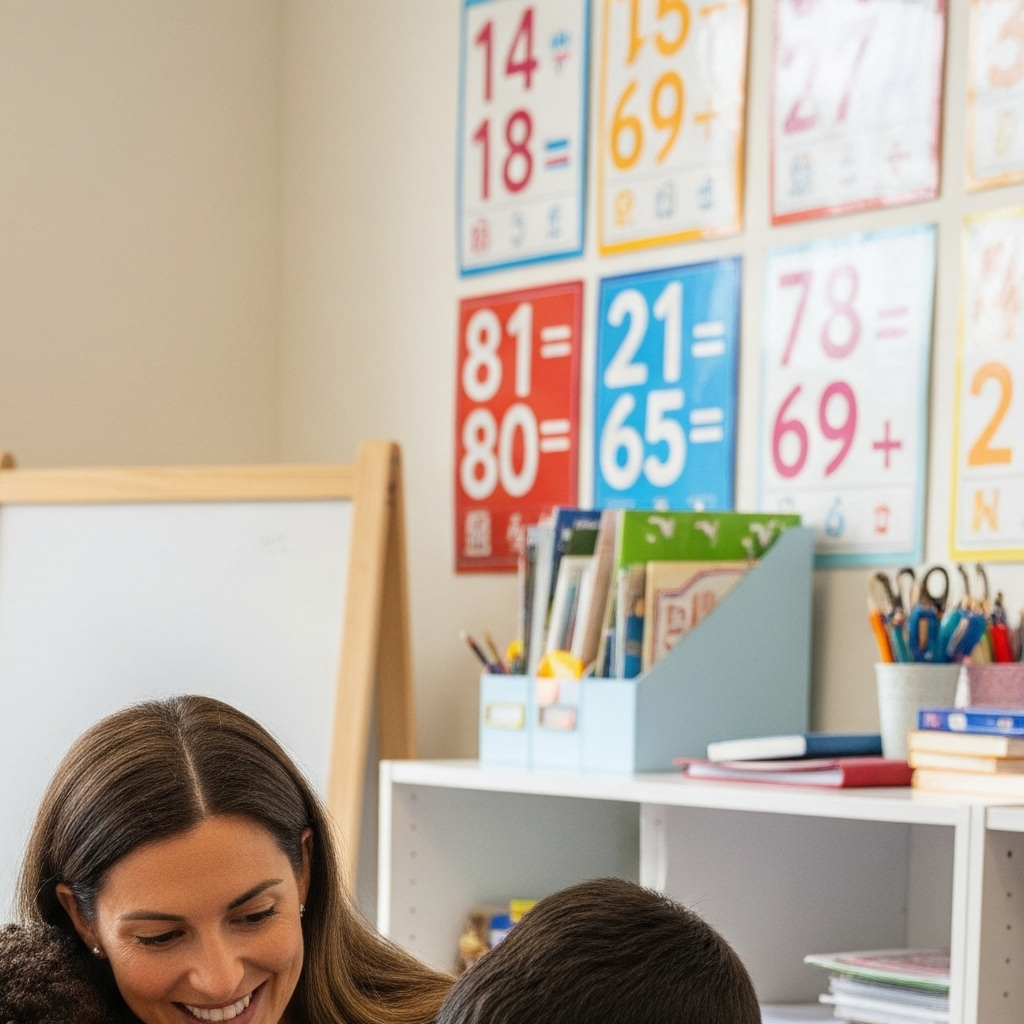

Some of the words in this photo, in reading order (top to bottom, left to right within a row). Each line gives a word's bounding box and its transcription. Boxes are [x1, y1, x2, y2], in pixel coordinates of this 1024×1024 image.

[474, 6, 539, 103] 14
[473, 108, 533, 201] 18
[609, 70, 685, 170] 69
[779, 264, 862, 367] 78
[771, 381, 858, 479] 69
[967, 360, 1013, 467] 2
